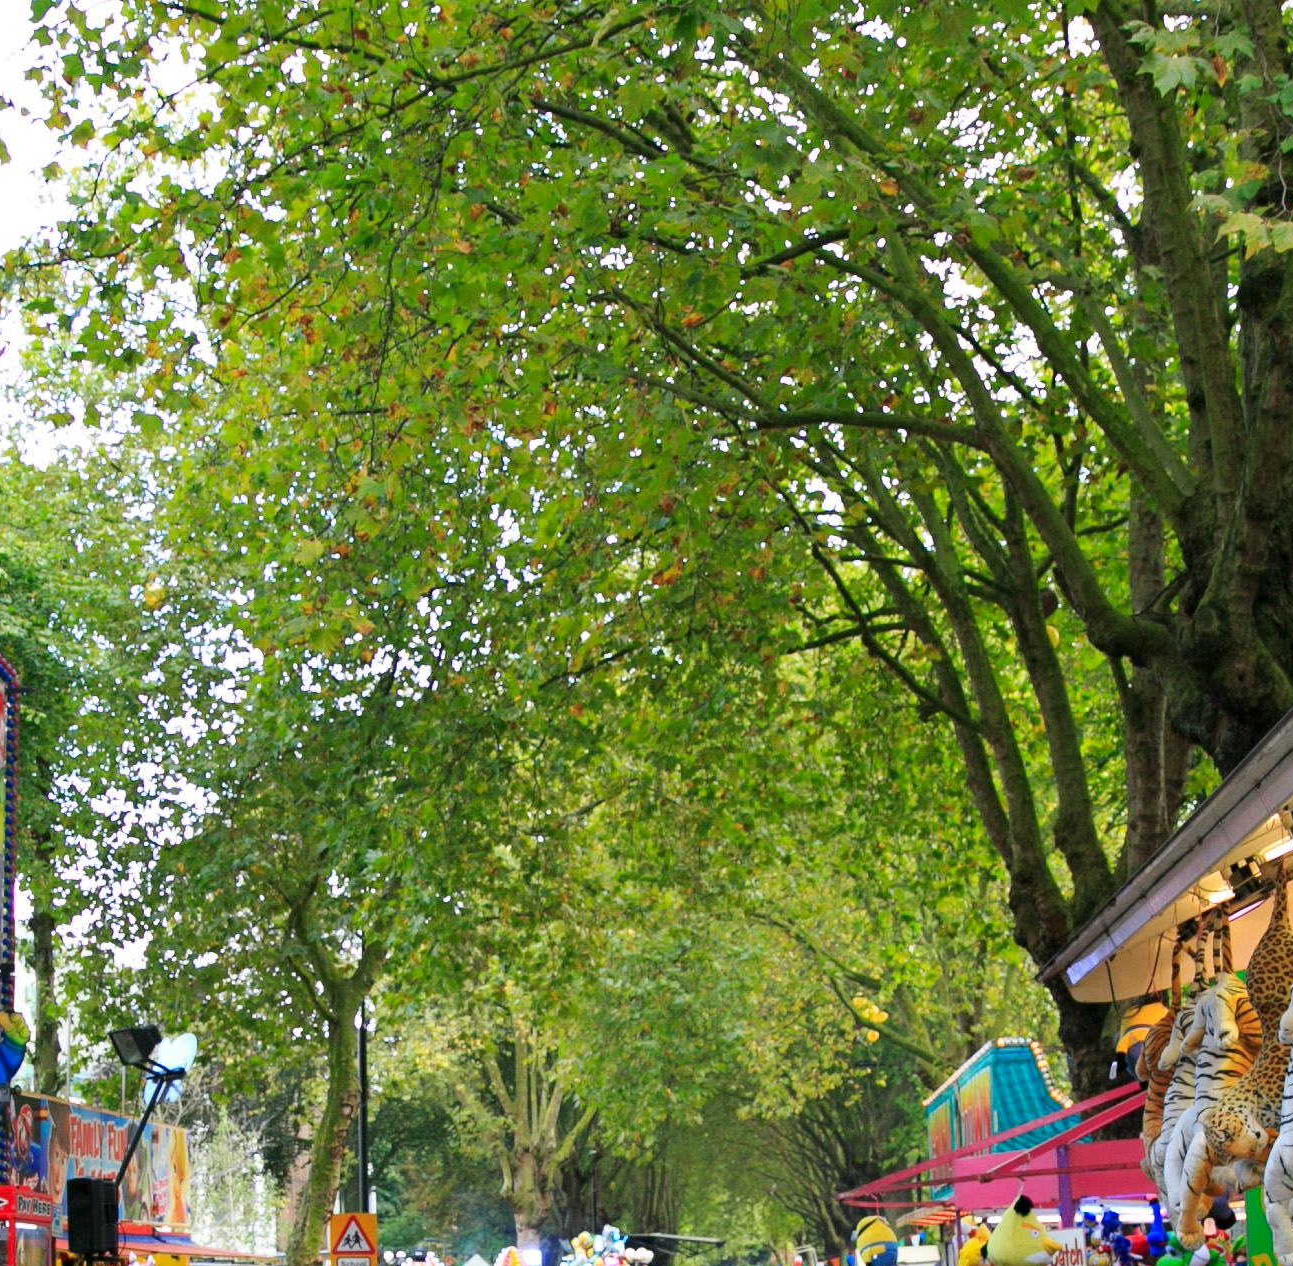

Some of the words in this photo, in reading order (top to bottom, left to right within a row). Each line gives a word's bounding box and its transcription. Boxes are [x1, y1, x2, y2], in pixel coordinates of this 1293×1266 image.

[68, 1113, 104, 1159] FAMILY
[17, 1195, 31, 1215] PAY
[32, 1198, 52, 1217] HERE
